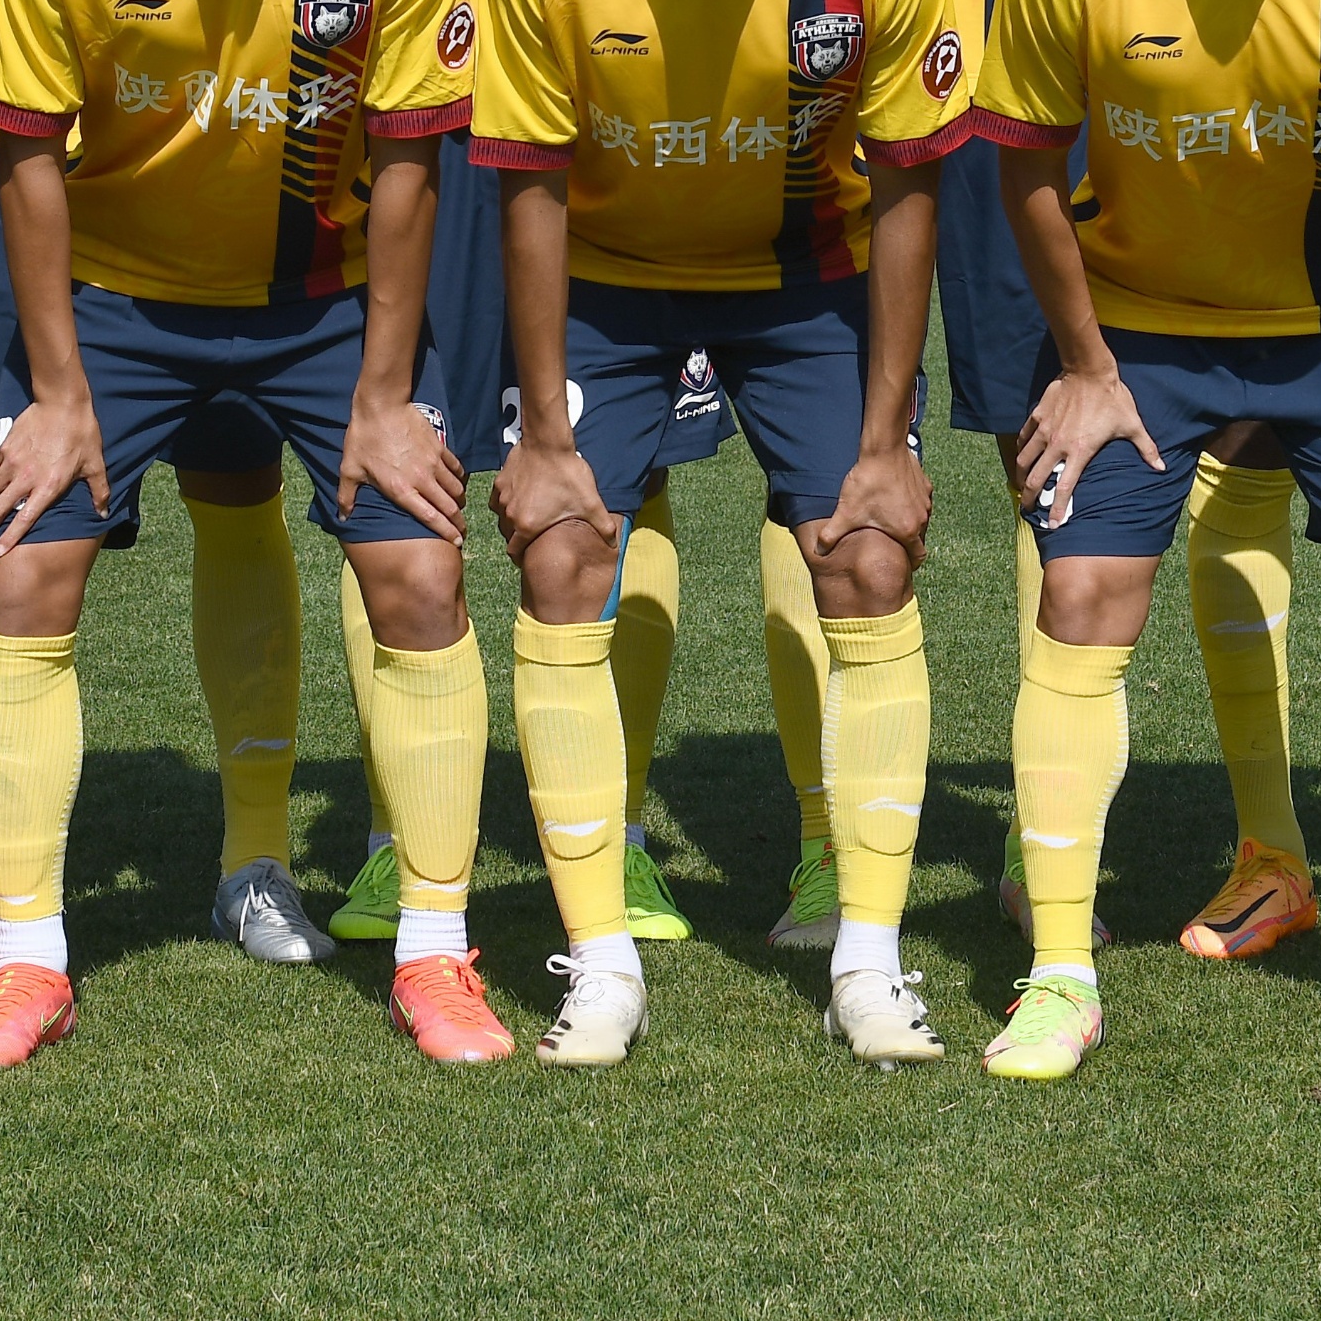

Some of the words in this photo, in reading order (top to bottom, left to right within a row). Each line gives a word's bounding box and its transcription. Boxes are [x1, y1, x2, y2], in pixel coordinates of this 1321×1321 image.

[114, 10, 172, 21] LI-NING
[799, 23, 857, 39] ATHLETIC
[590, 45, 649, 57] LI-NING
[1123, 49, 1183, 61] LI-NING
[114, 62, 358, 134] 陕西体彩
[587, 91, 846, 168] 陕西体彩
[675, 400, 721, 420] LI-NING
